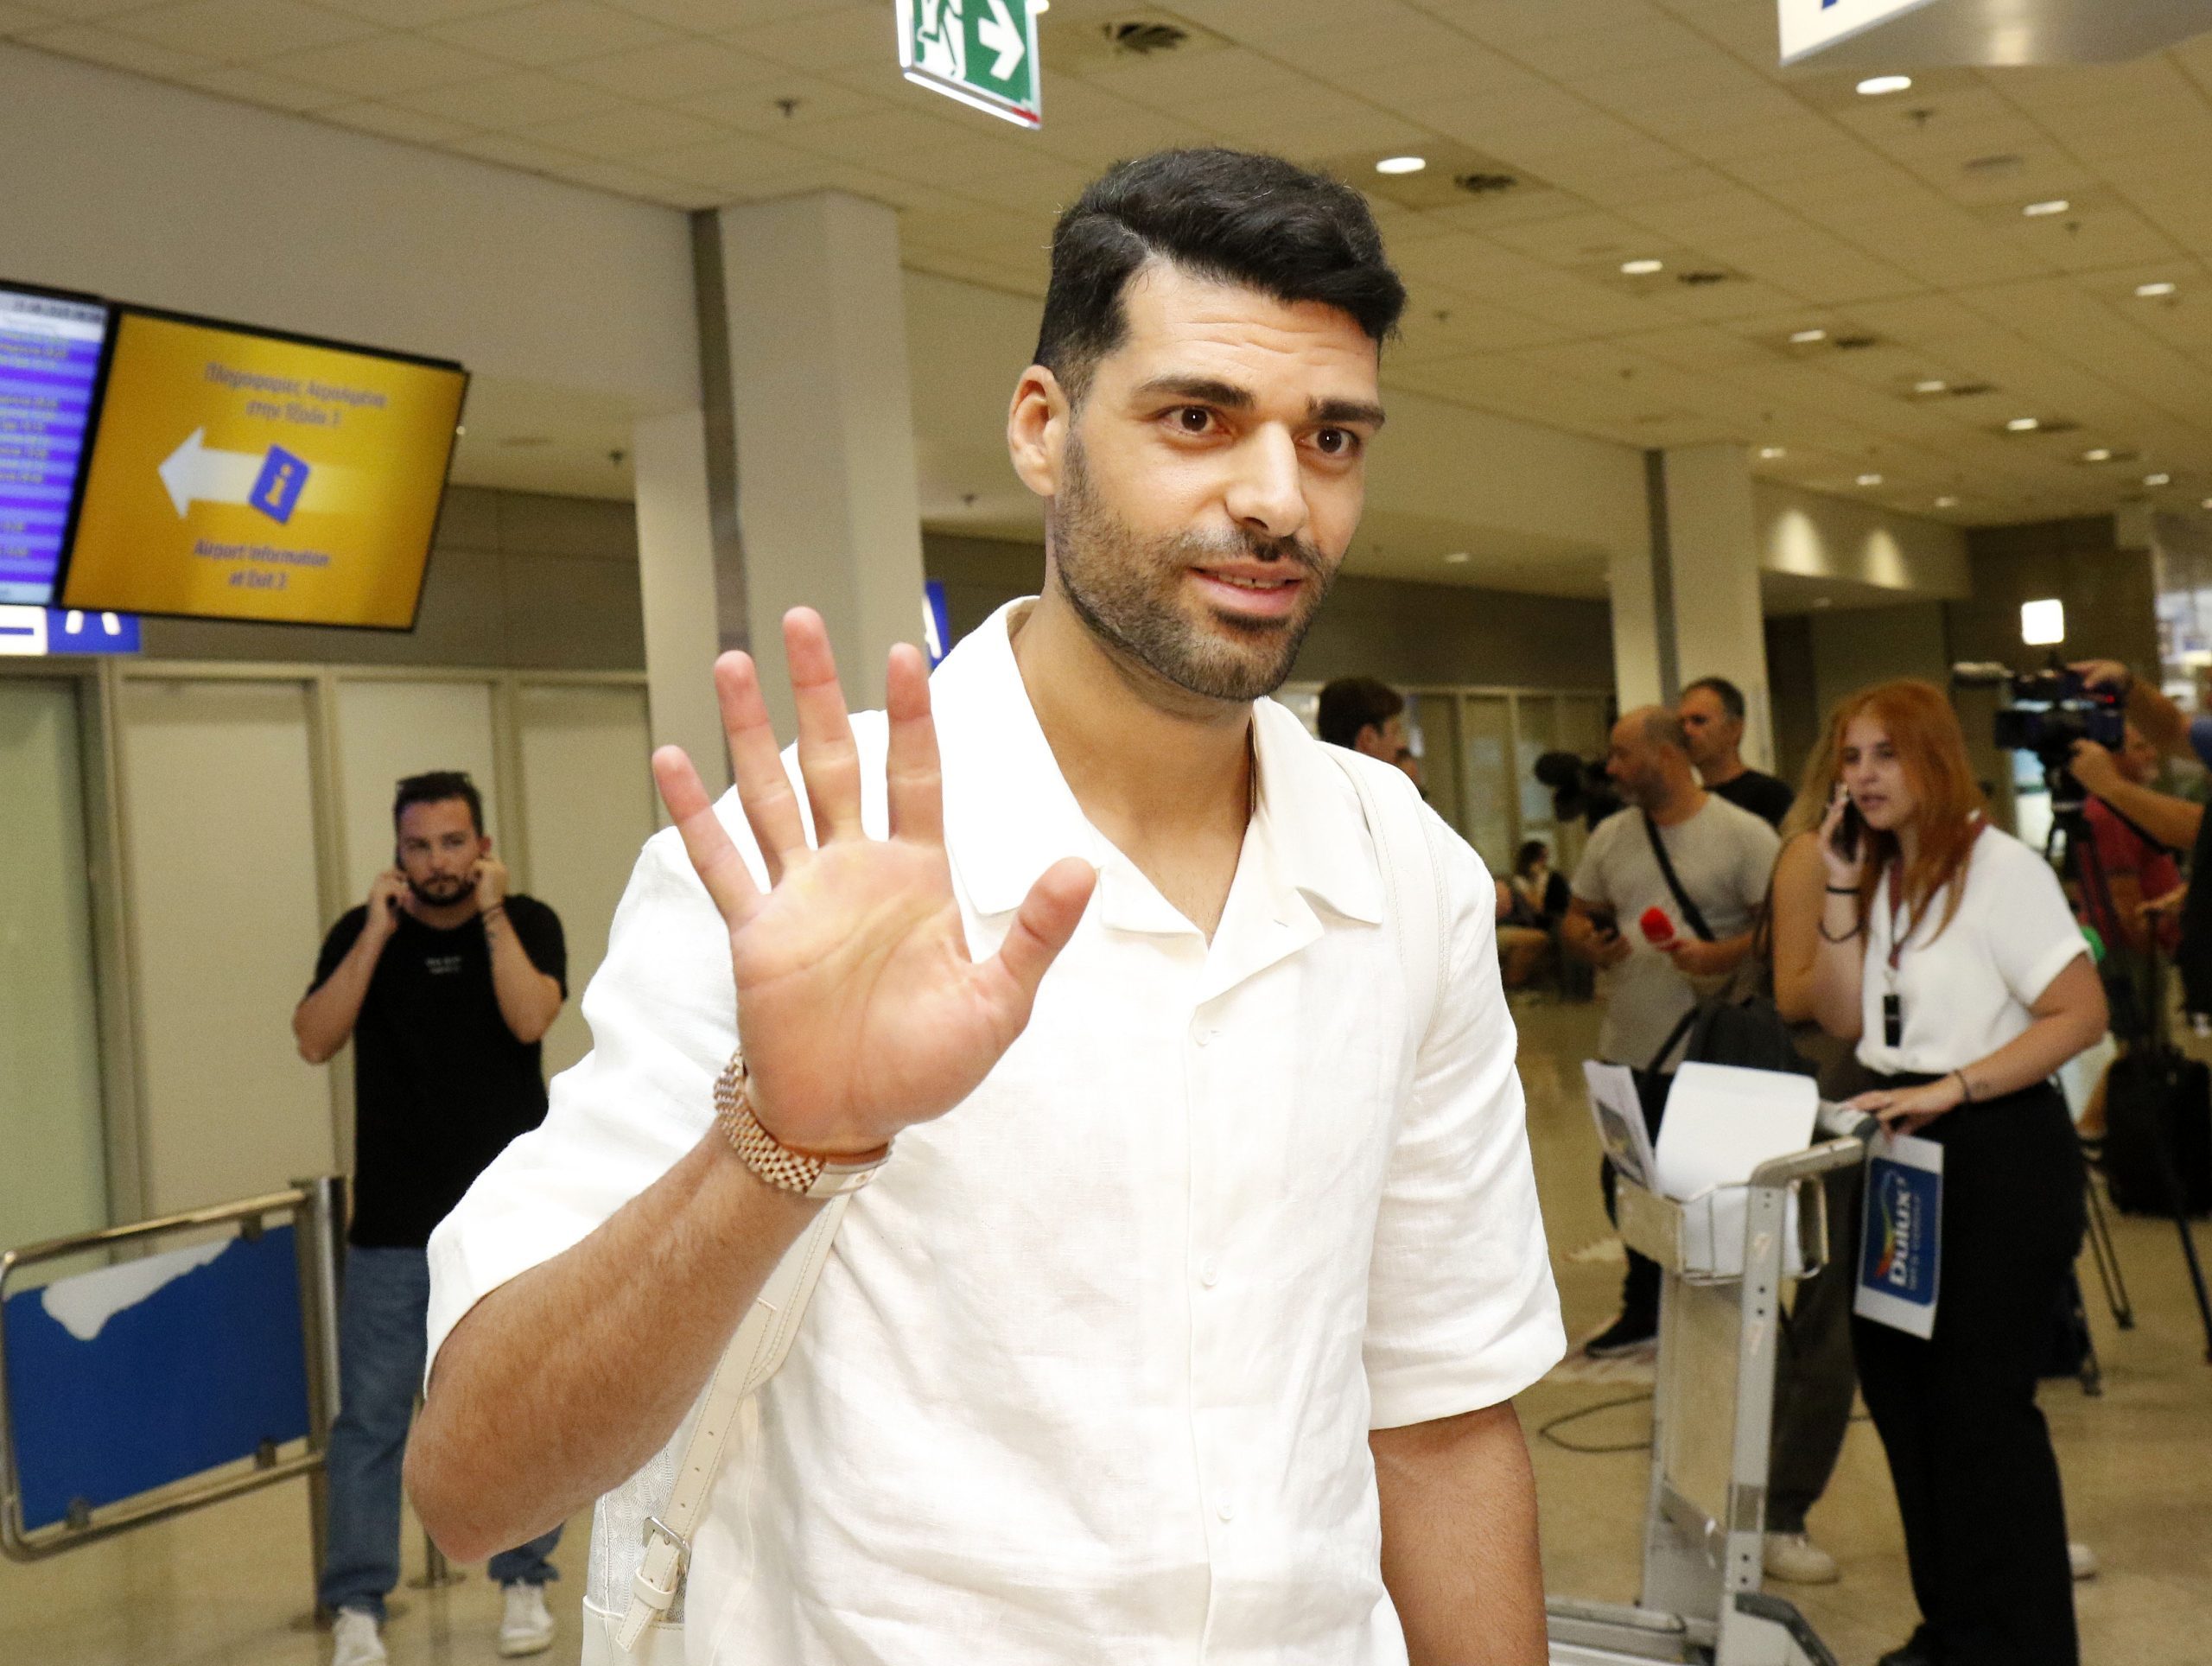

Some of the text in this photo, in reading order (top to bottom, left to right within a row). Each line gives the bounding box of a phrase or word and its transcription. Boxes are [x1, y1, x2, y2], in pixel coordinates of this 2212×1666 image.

[194, 538, 245, 560] Airport
[229, 571, 243, 586] at
[1888, 1192, 1910, 1288] Dulux
